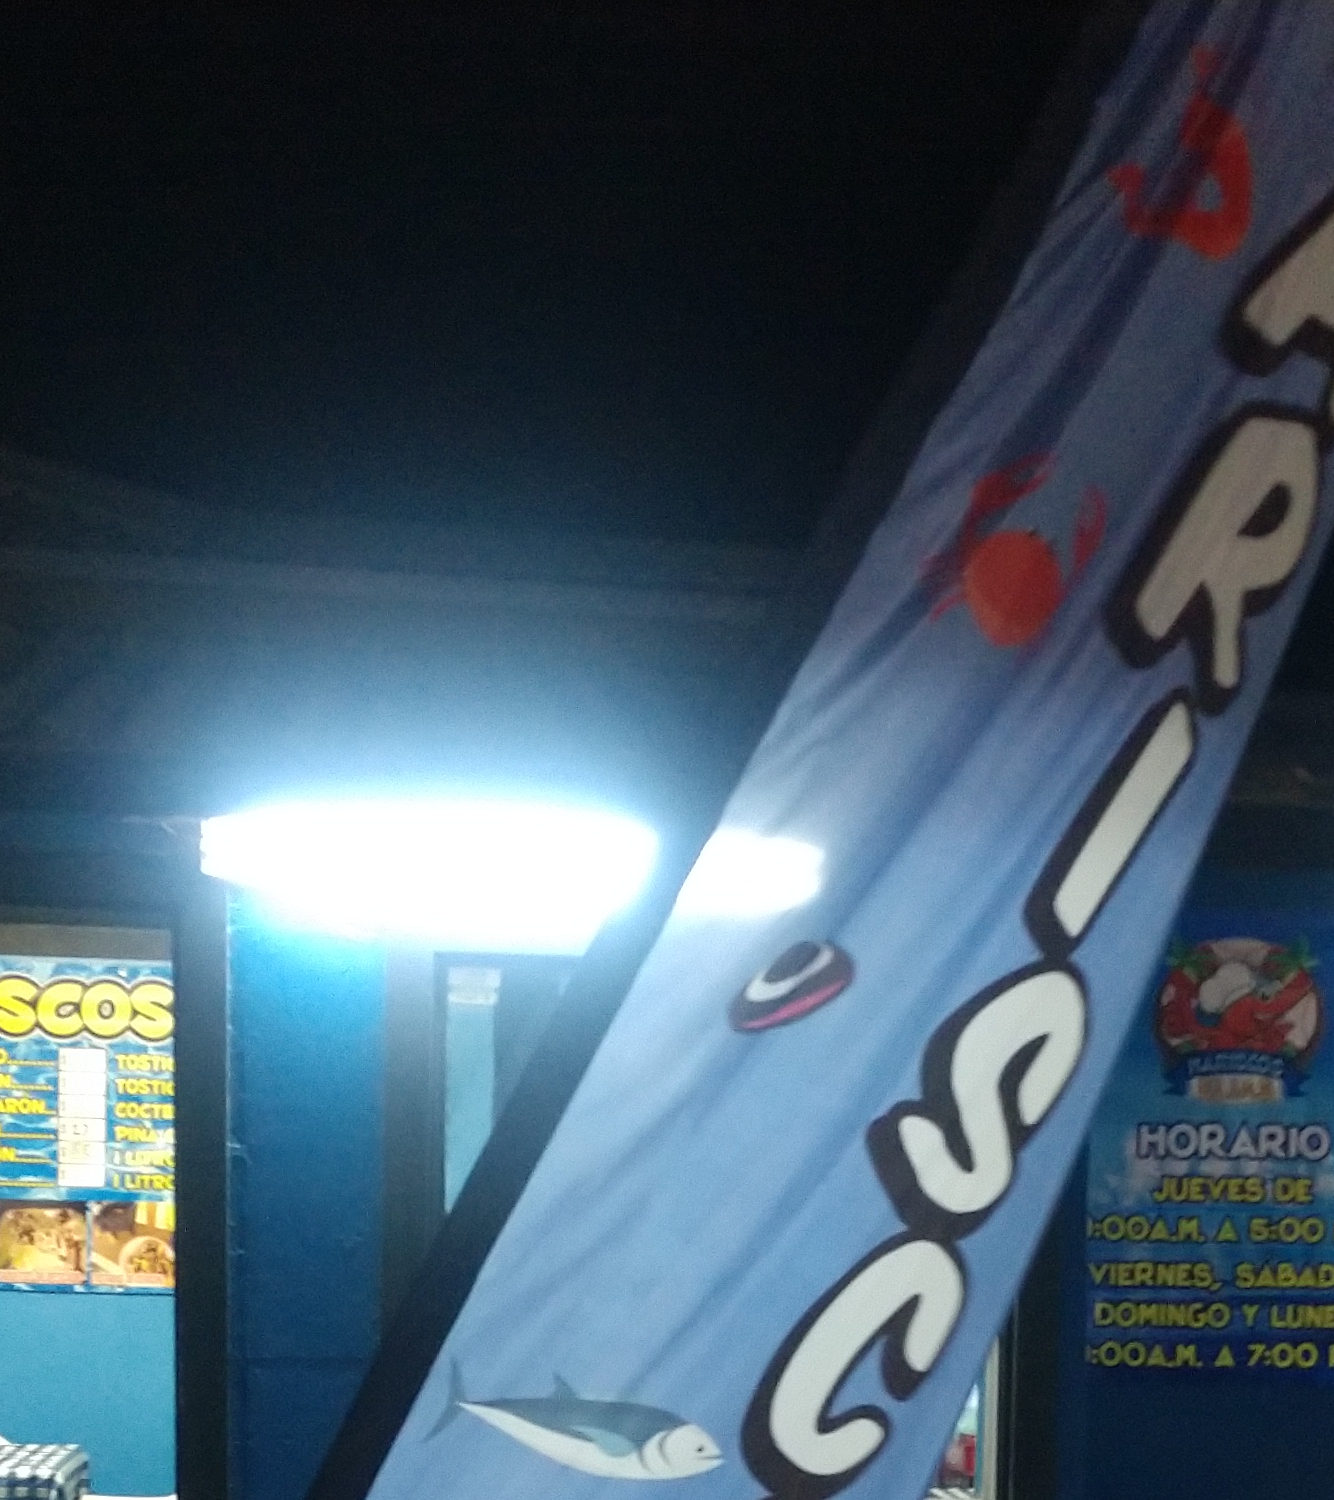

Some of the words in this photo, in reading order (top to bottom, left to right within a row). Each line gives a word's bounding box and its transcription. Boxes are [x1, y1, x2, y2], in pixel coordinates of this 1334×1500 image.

[1136, 1121, 1331, 1161] HORARIO
[1152, 1175, 1264, 1203] JUEVES
[1273, 1176, 1314, 1203] DE
[1215, 1217, 1239, 1242] A
[1089, 1261, 1222, 1290] VIERNES,
[1094, 1302, 1232, 1328] DOMINGO
[1242, 1304, 1260, 1327] Y
[1213, 1343, 1236, 1367] A
[1246, 1342, 1317, 1368] 7:00
